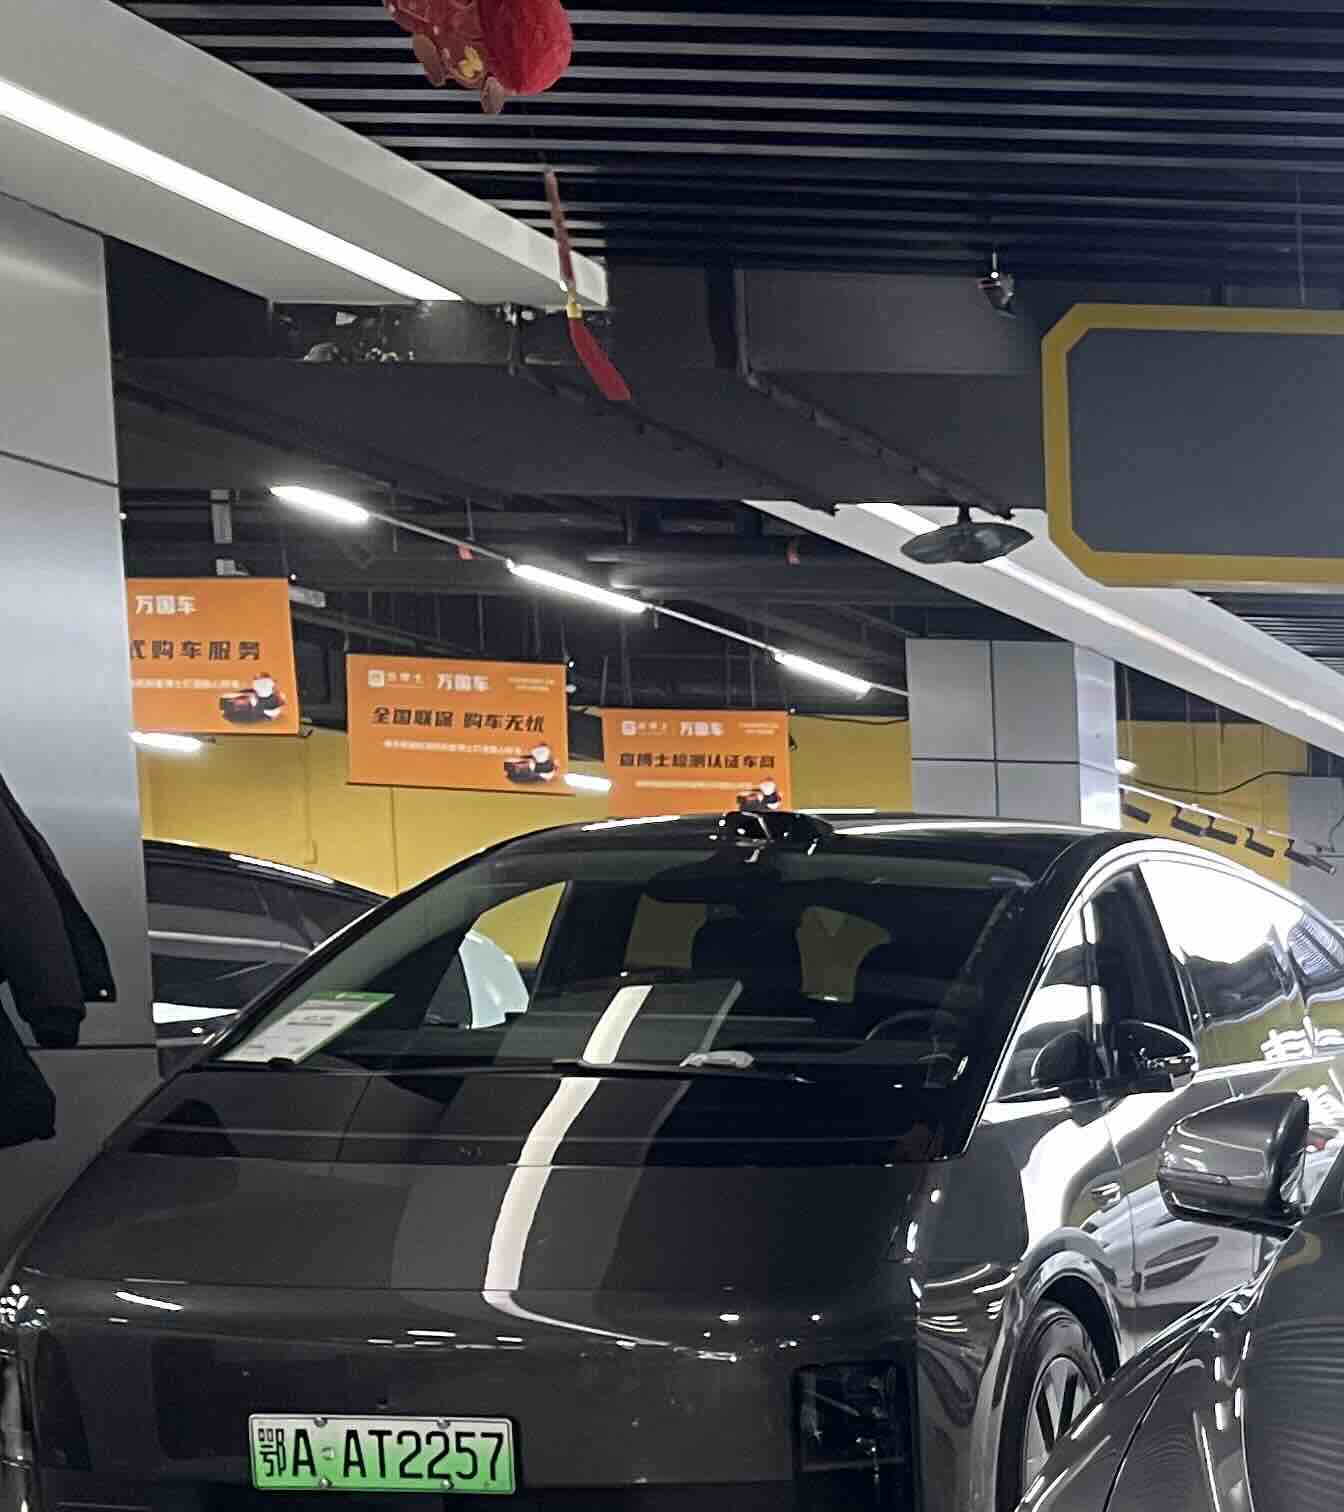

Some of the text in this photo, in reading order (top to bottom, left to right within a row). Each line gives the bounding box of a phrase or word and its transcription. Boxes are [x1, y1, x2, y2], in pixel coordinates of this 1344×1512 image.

[135, 594, 196, 615] 万国车
[437, 672, 490, 691] 万国车
[373, 706, 545, 733] 全国联保 购车无忧
[343, 1428, 505, 1481] AT2257
